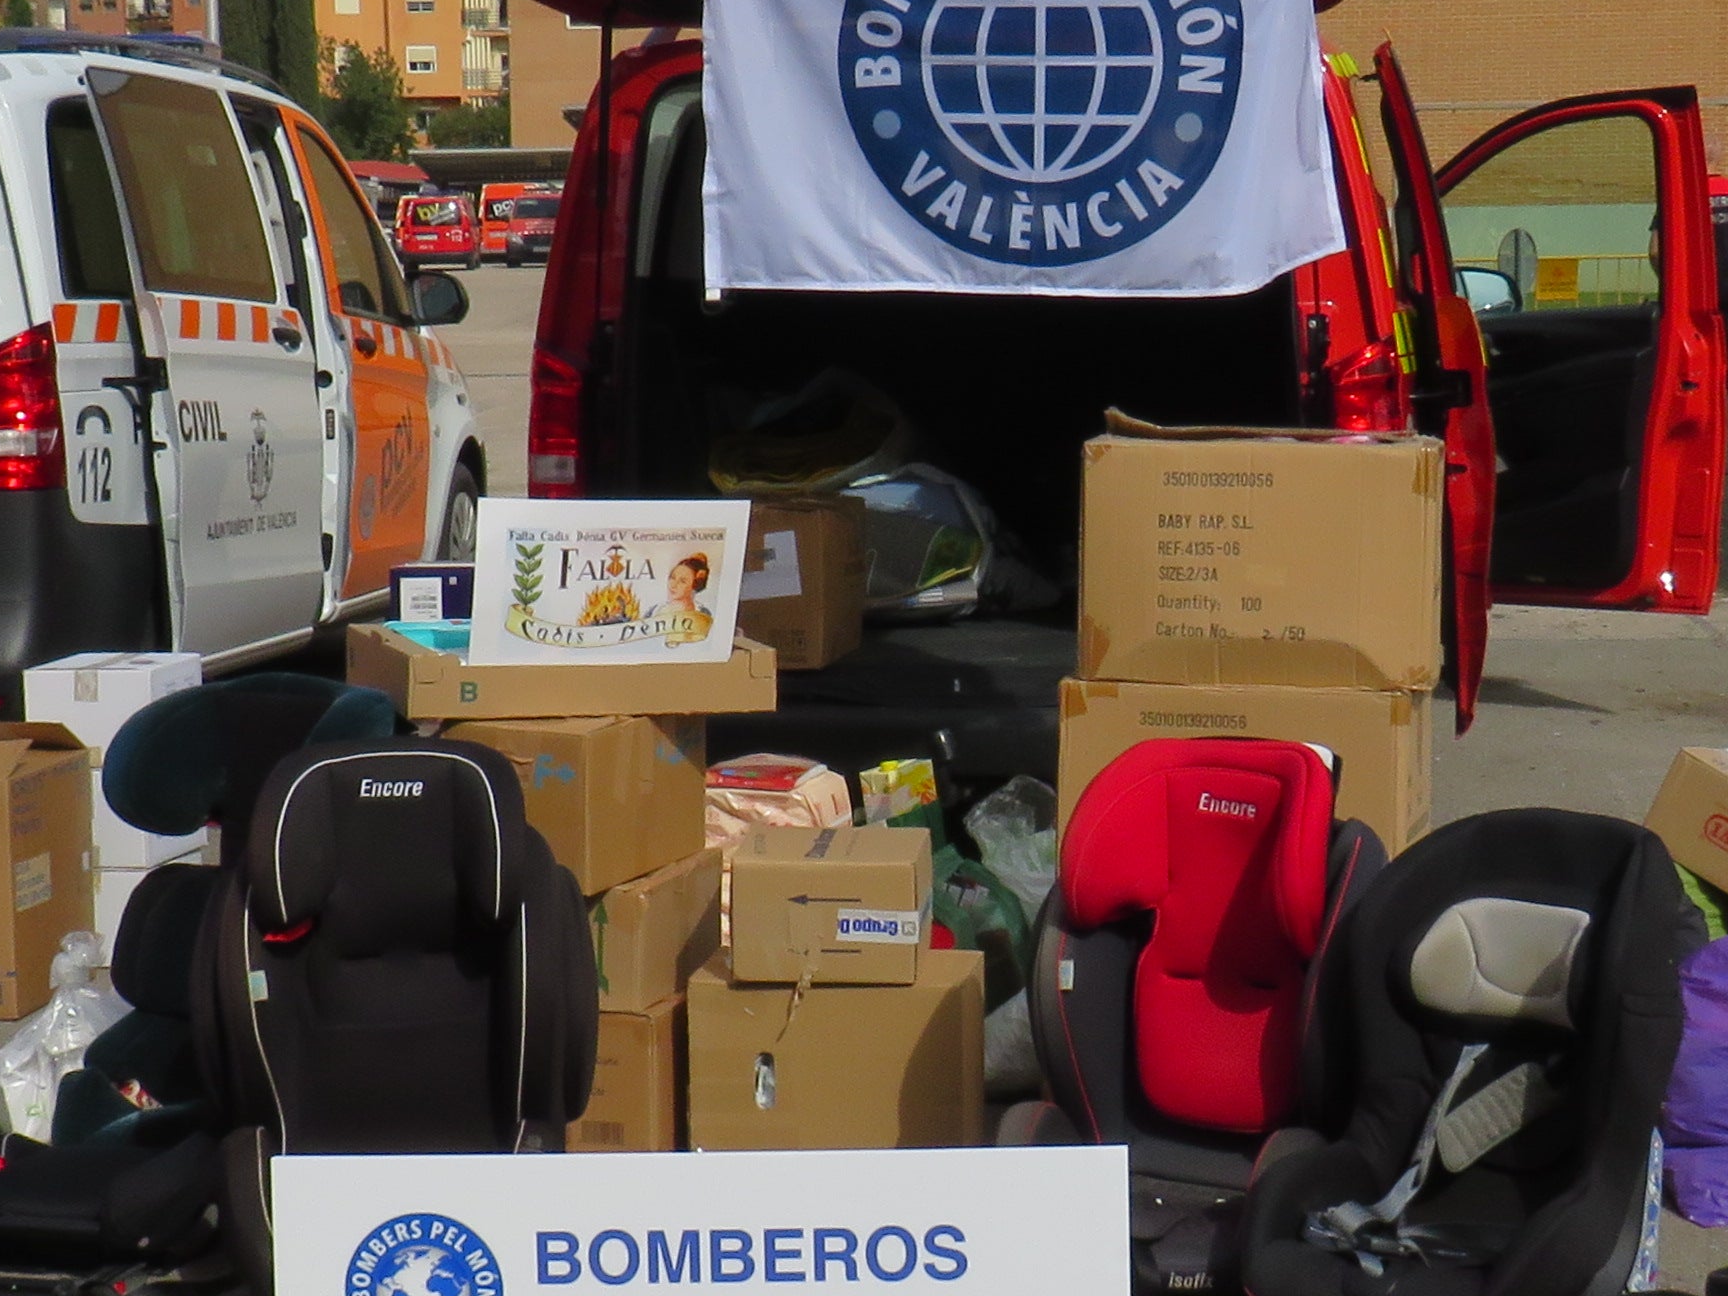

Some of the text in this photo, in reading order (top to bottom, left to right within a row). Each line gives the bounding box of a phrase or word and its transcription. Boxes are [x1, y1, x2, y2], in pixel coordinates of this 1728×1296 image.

[900, 149, 1185, 251] VALÈNCIA
[178, 400, 227, 442] CIVIL
[77, 446, 112, 504] 112
[1158, 513, 1191, 529] BABY
[1241, 596, 1262, 612] 100
[1155, 621, 1203, 638] Carton
[460, 681, 478, 703] B
[359, 778, 424, 798] Encore
[1198, 792, 1257, 818] Encore
[852, 918, 898, 936] Grupo
[429, 1220, 468, 1252] PEL
[535, 1225, 969, 1285] BOMBEROS
